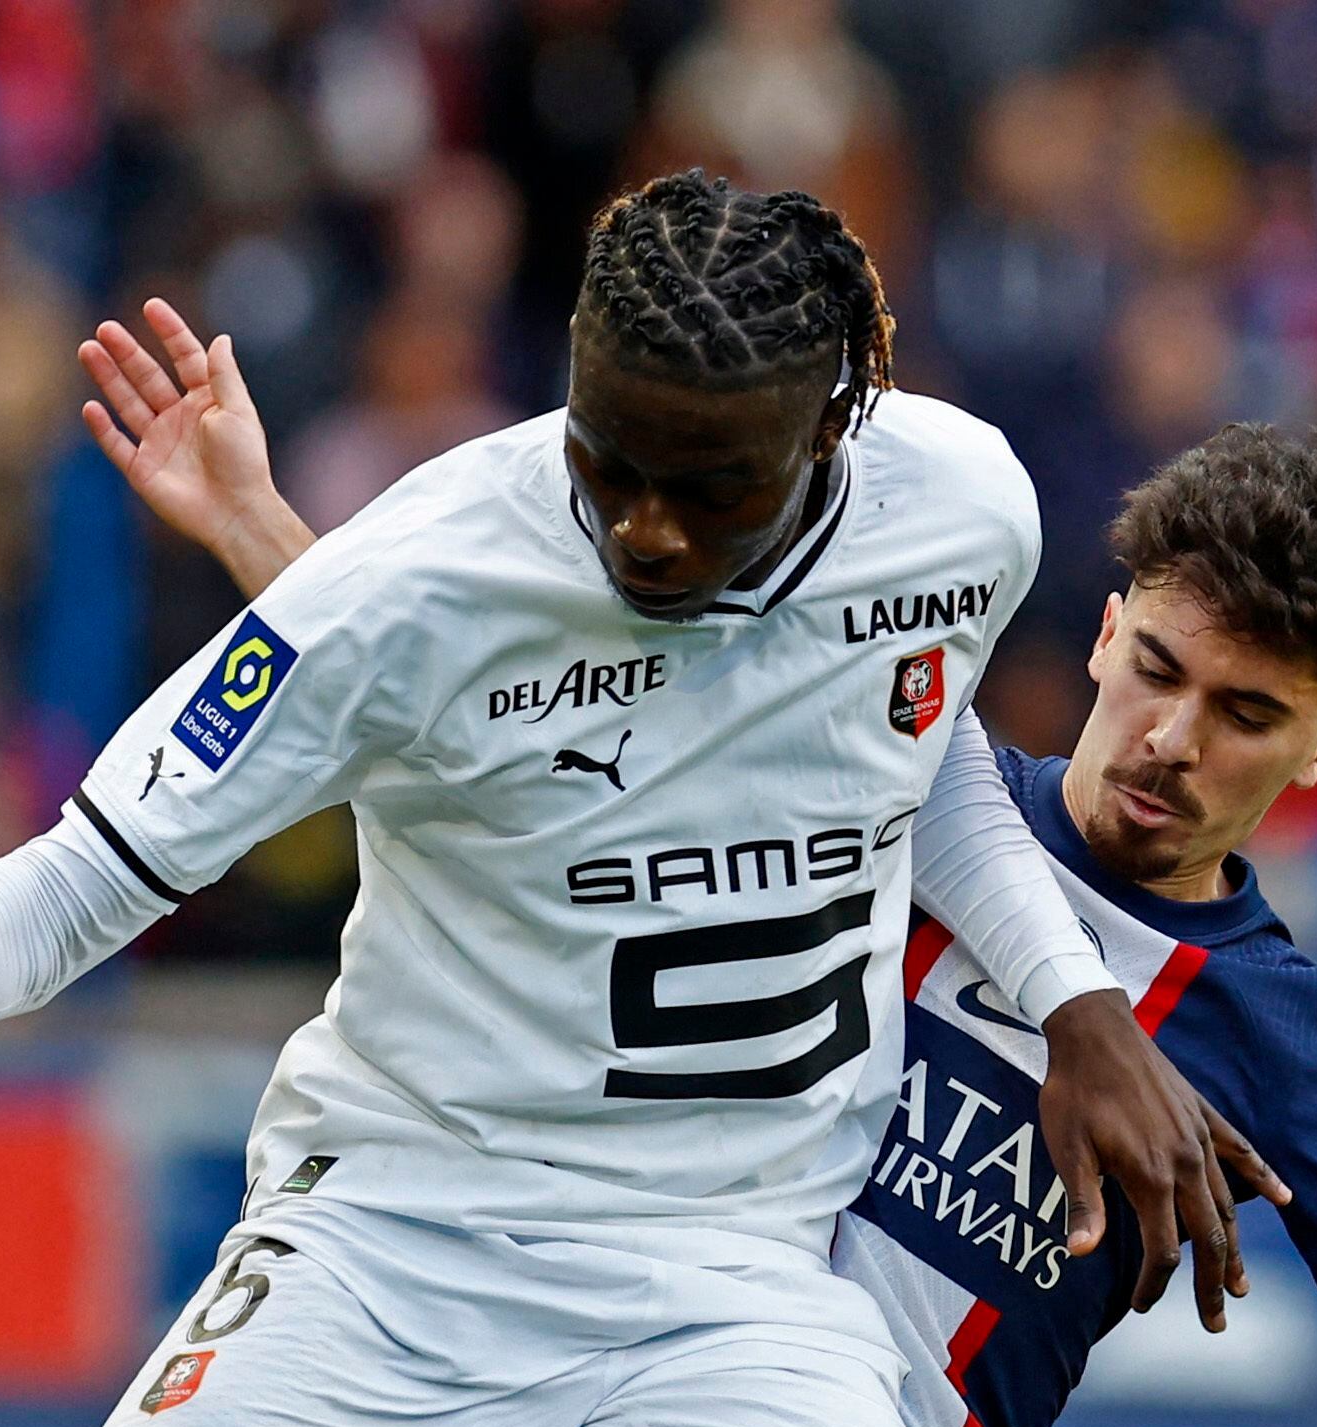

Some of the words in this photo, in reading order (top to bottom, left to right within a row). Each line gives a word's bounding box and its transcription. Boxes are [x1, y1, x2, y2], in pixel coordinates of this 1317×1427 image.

[843, 578, 998, 644] LAUNAY
[195, 697, 232, 734] LIGUE
[227, 727, 238, 739] 1
[488, 680, 547, 721] DEL
[521, 654, 666, 724] ARTE
[181, 711, 204, 738] Uber
[200, 730, 226, 758] Eats
[897, 1058, 1104, 1237] ATA
[873, 1141, 1073, 1290] IRWAYS
